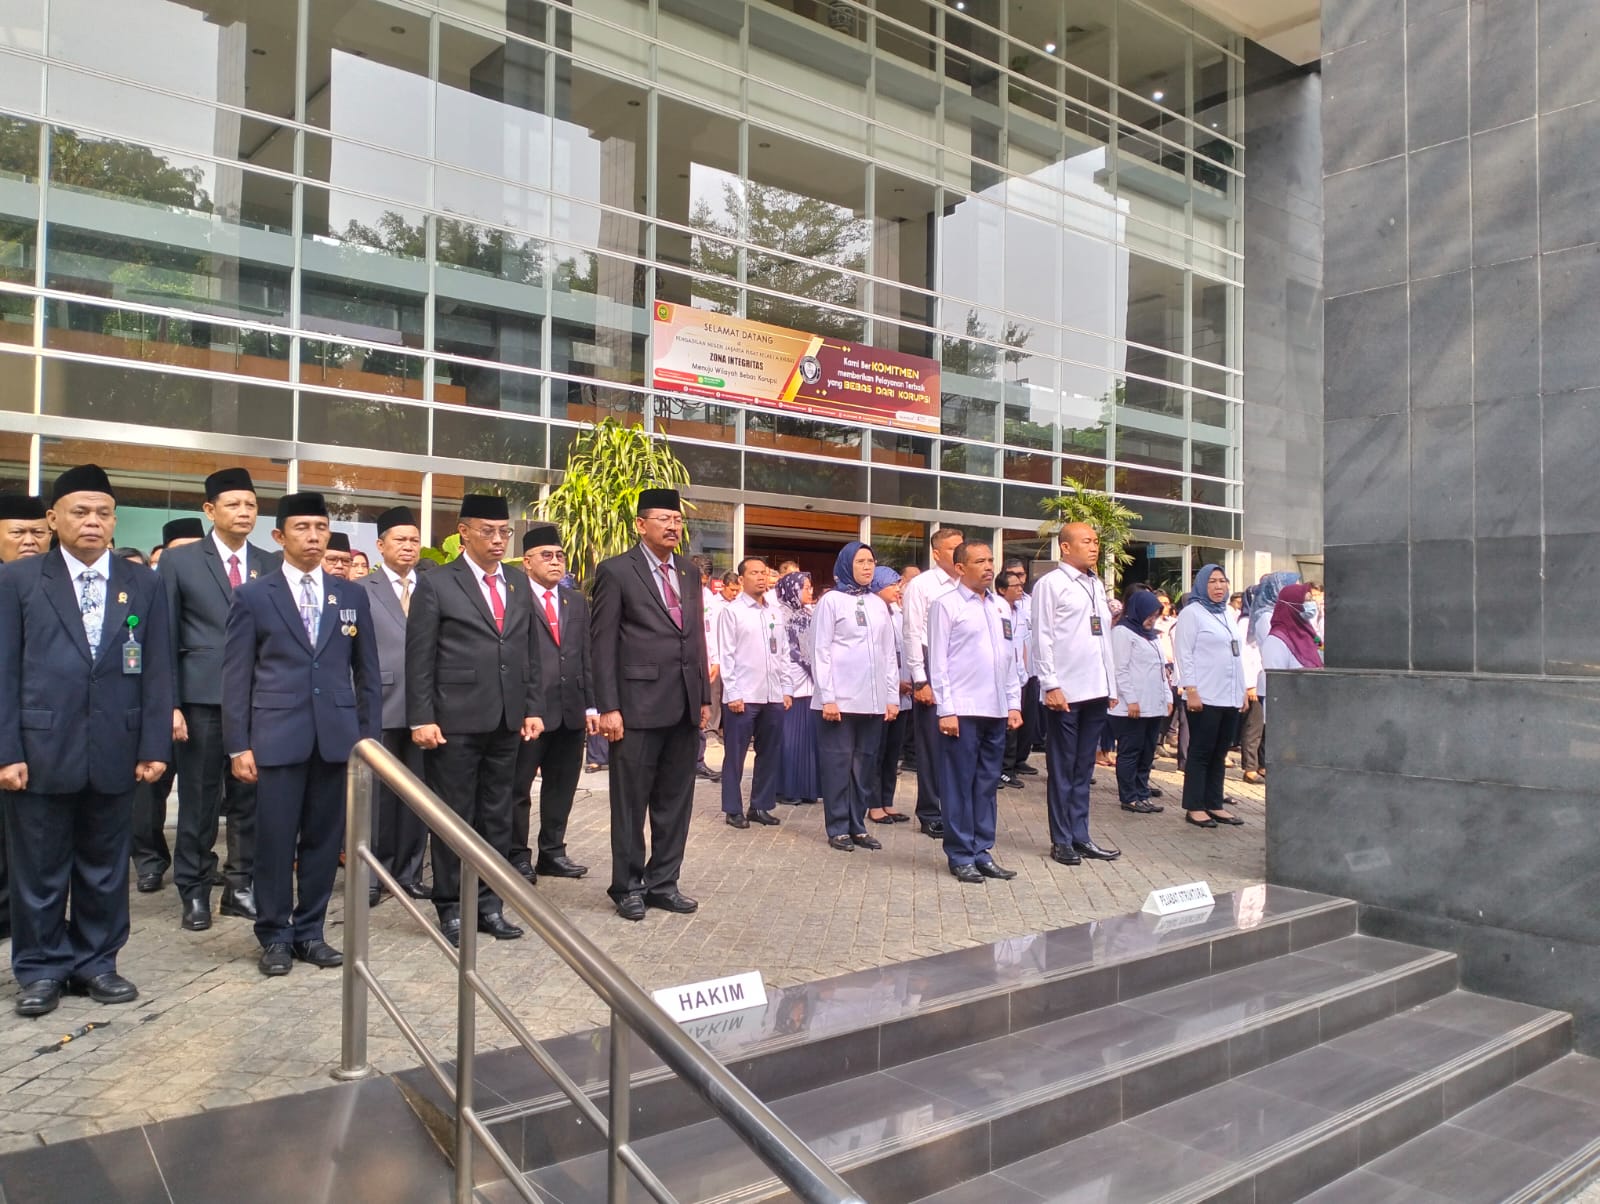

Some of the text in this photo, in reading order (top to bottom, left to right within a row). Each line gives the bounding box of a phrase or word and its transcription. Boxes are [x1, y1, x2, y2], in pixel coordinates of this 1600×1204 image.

[704, 323, 773, 344] SELAMAT DATANG
[709, 352, 764, 370] ZONA INTEGRITAS
[843, 357, 859, 369] Kami
[691, 362, 777, 385] Menuju Wilayah Bebas Korupsi
[837, 369, 925, 392] memberikan Pelayanan Terbaik
[827, 378, 930, 403] yang BEBAS DARI KORUPSI
[678, 983, 745, 1011] HAKIM
